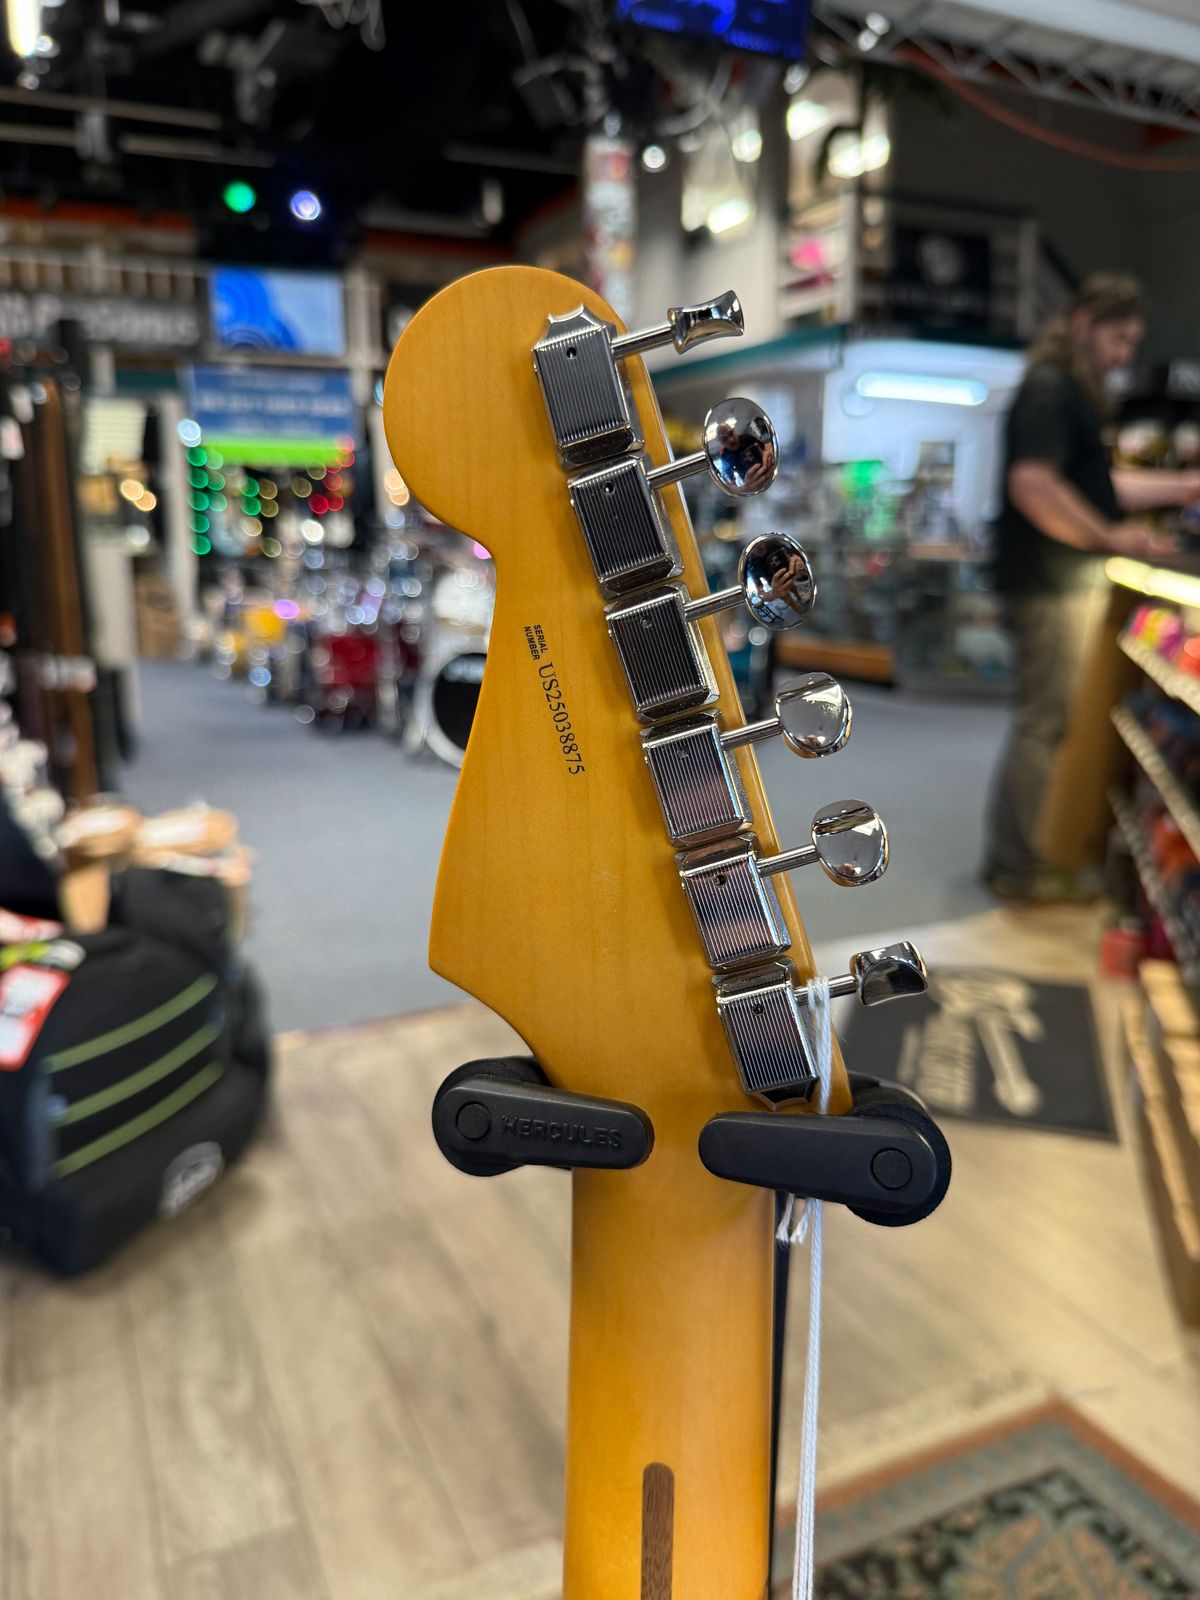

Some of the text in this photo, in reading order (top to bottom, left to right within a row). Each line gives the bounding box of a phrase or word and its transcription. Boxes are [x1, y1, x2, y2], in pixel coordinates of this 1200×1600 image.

[524, 626, 540, 661] NUMBER
[533, 624, 548, 653] SERIAL
[538, 662, 585, 775] US25038875
[501, 1115, 622, 1149] HERCULES
